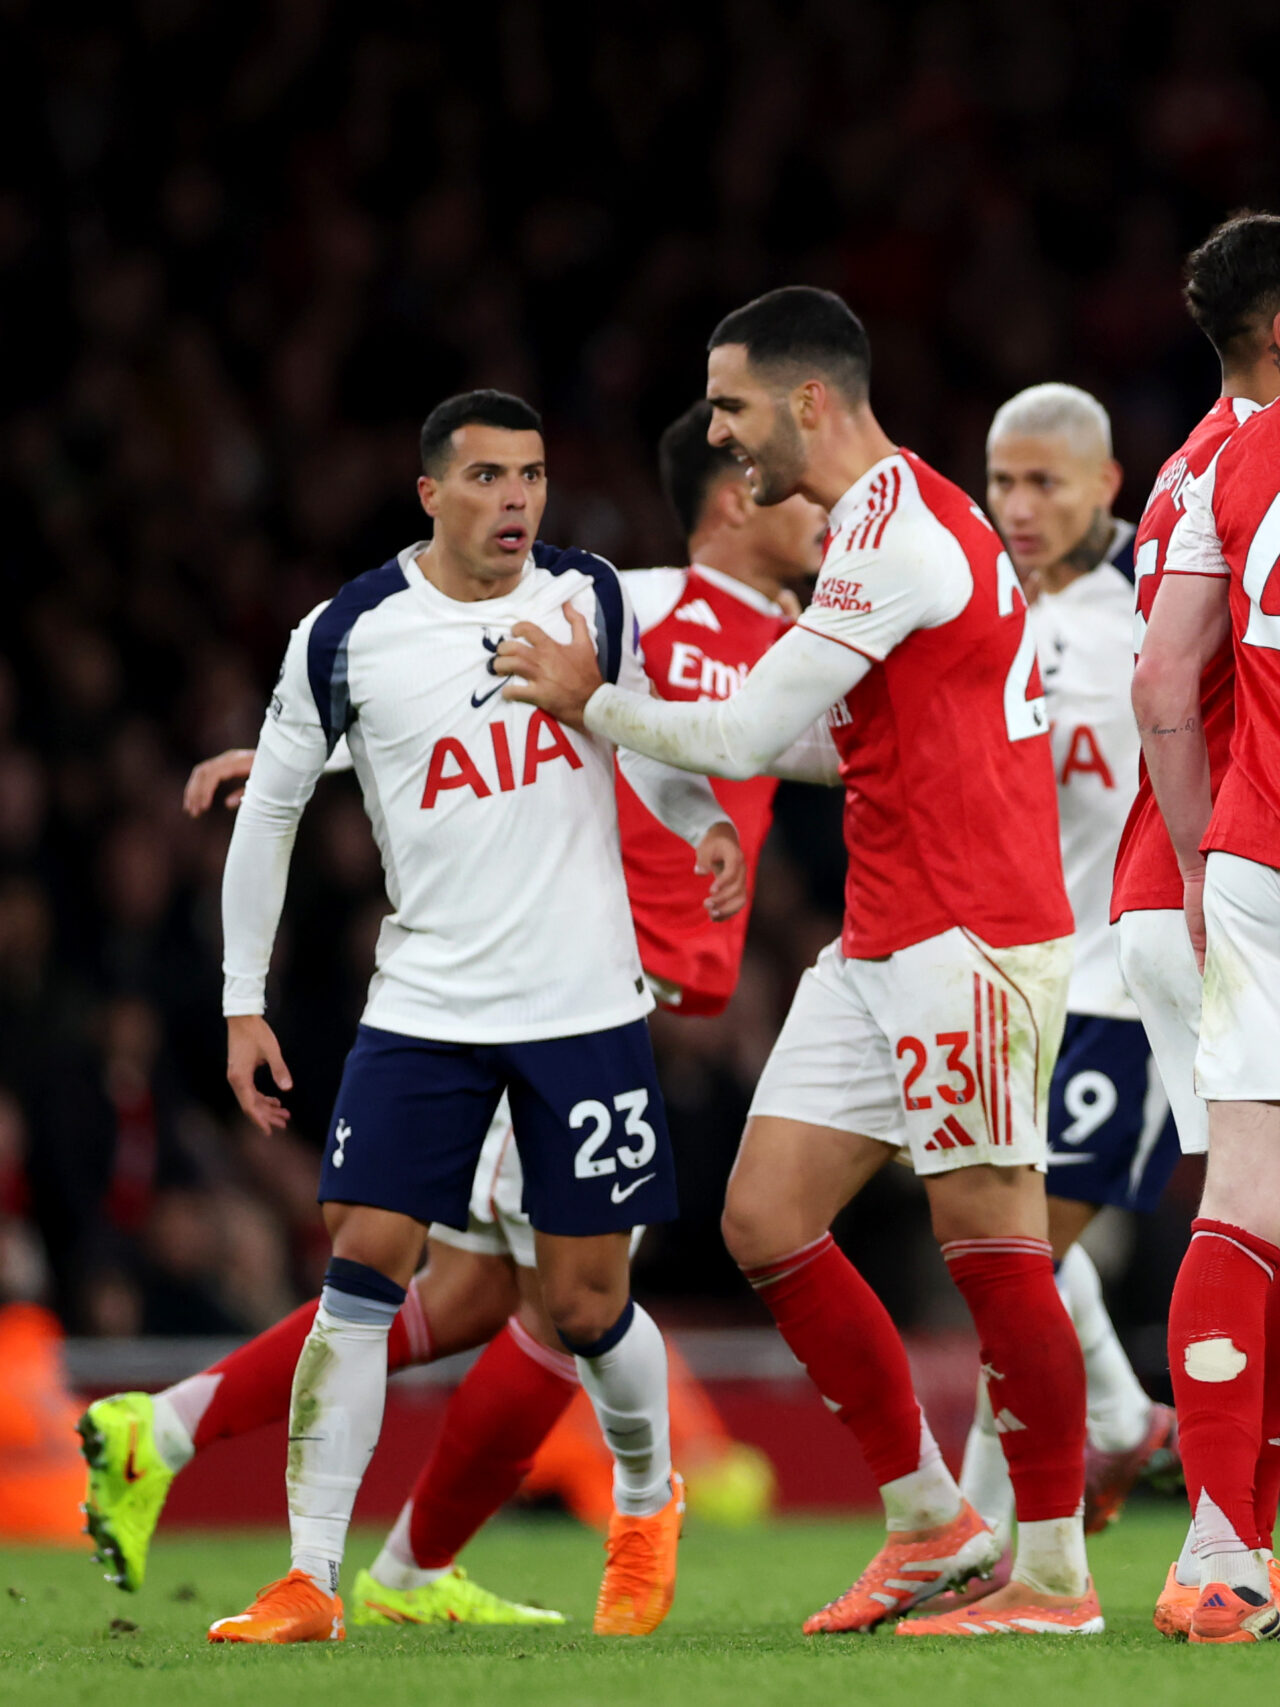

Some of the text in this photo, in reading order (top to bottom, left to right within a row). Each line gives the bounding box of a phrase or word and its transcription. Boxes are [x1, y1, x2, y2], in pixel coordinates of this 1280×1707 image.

[822, 578, 863, 596] VISIT
[668, 641, 749, 698] Emi
[996, 551, 1049, 743] 2
[420, 708, 584, 810] AIA
[896, 1031, 977, 1111] 23
[1061, 1070, 1119, 1145] 9
[569, 1088, 657, 1179] 23
